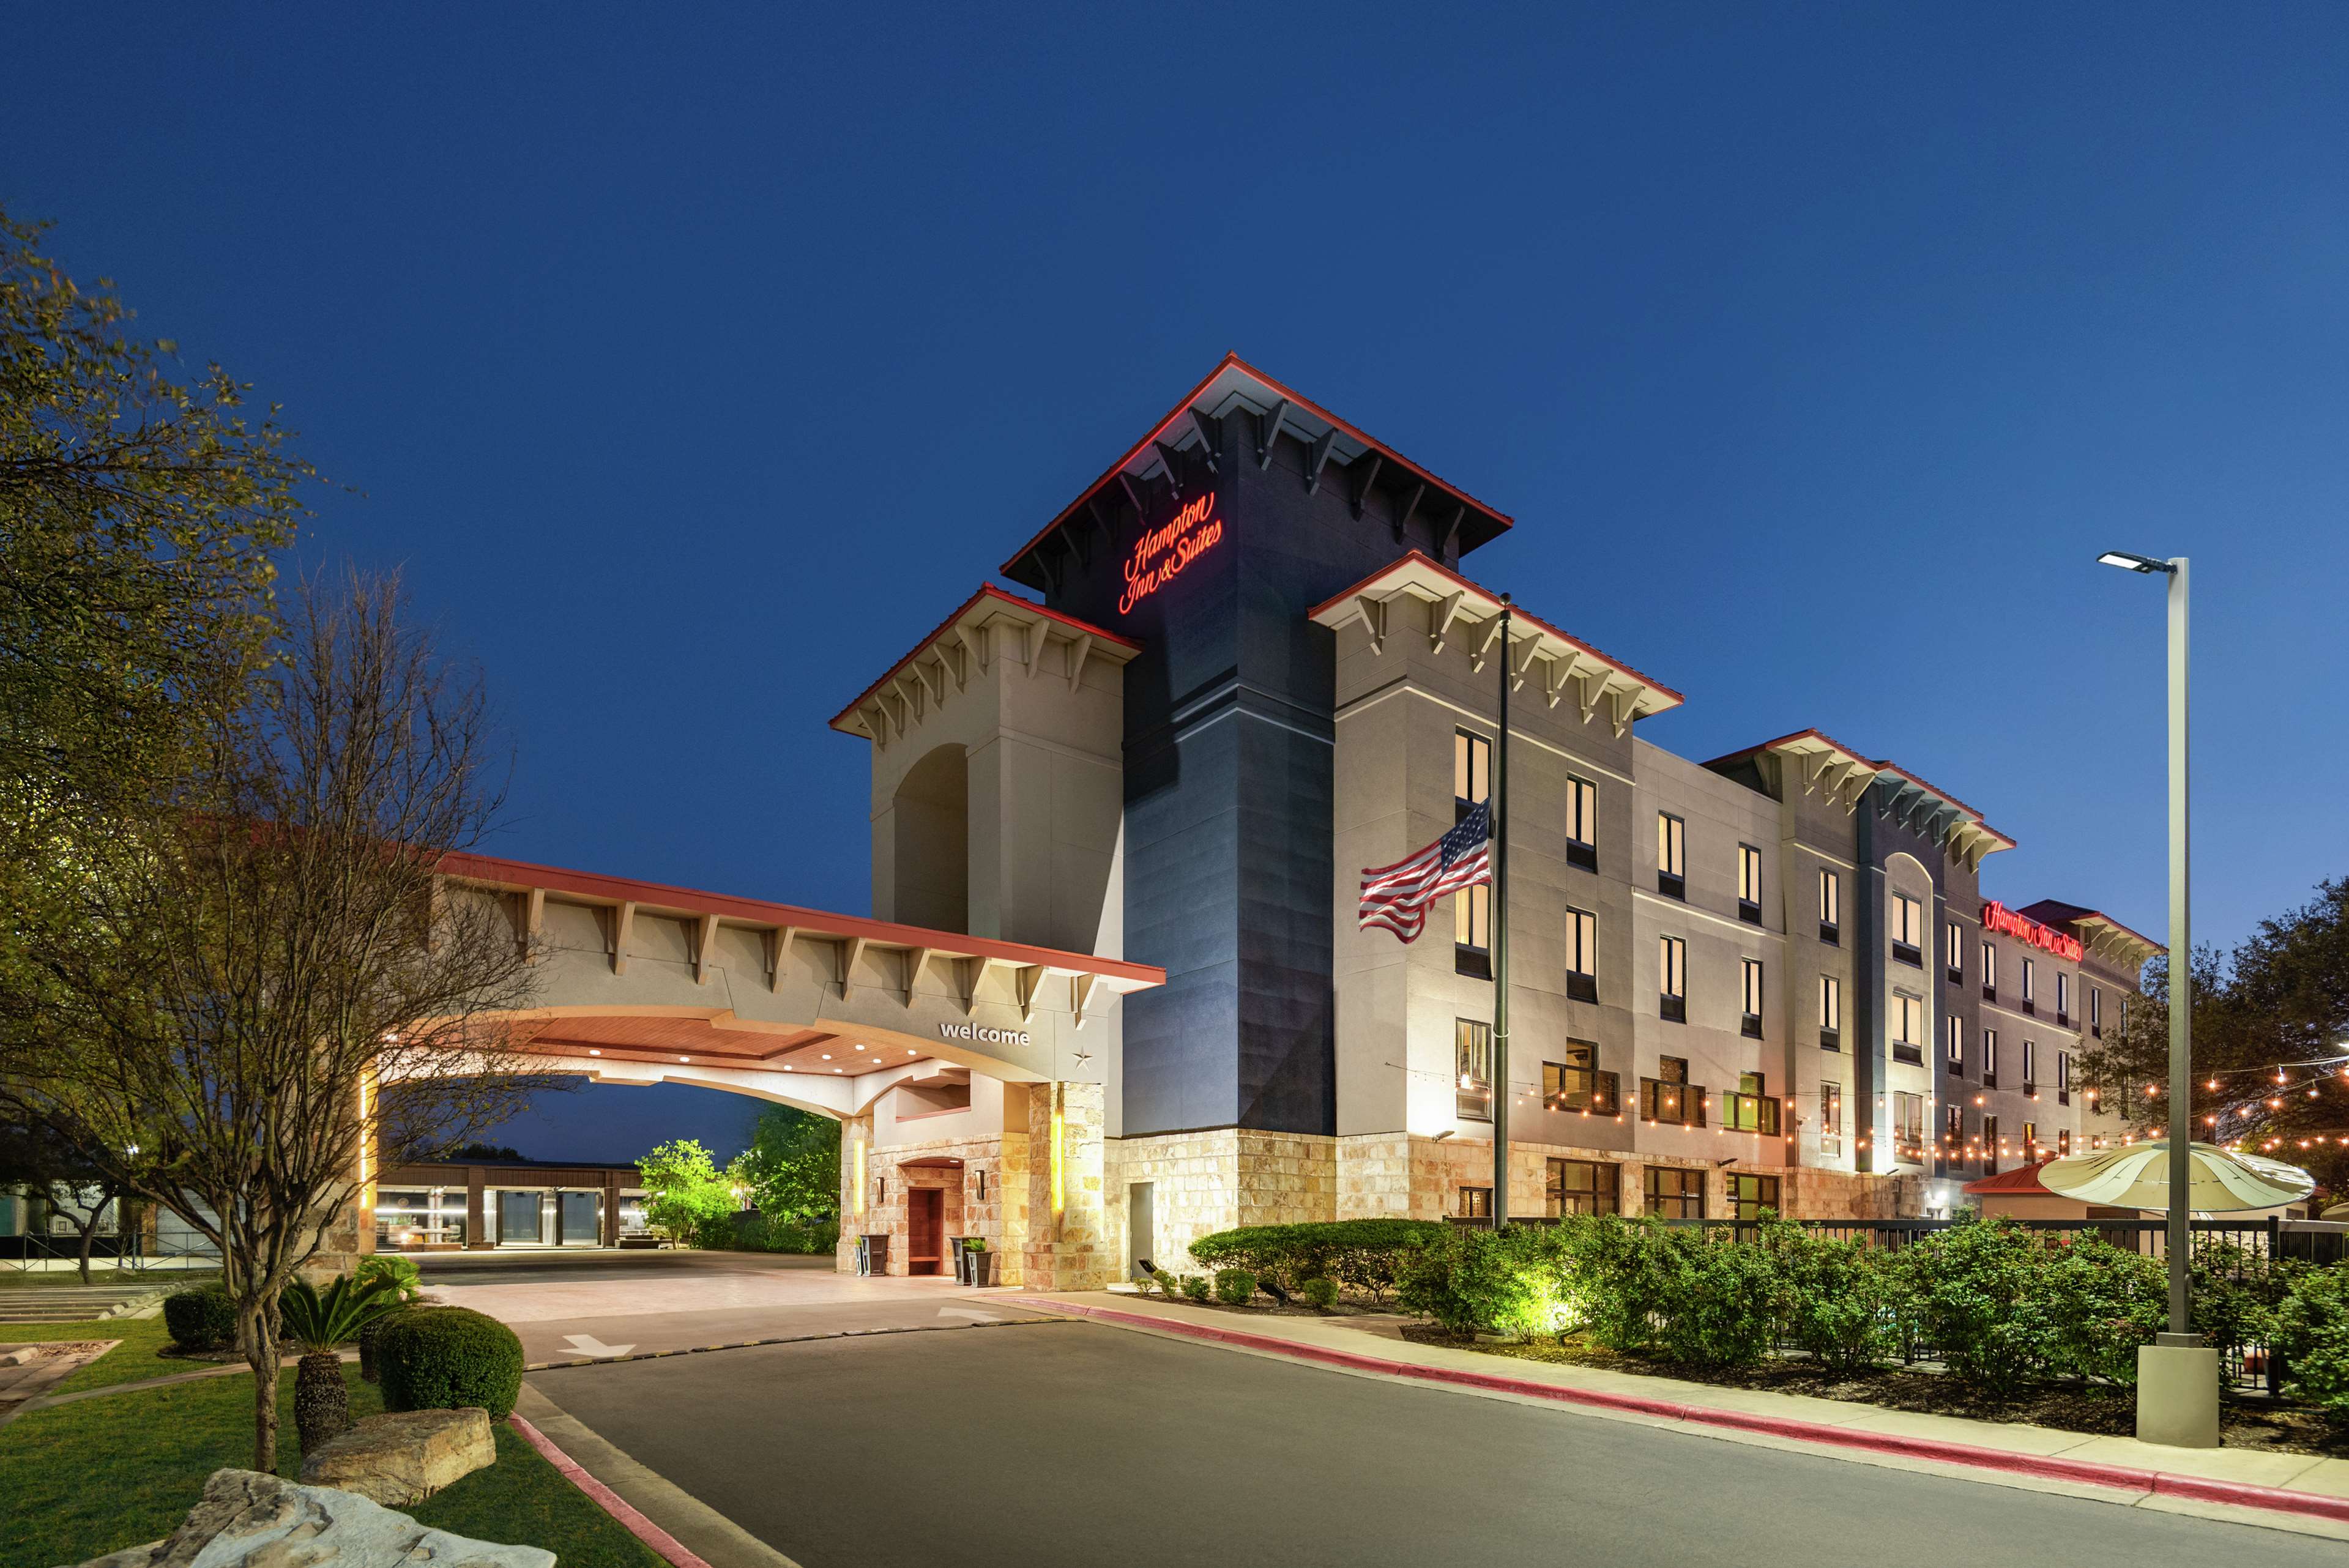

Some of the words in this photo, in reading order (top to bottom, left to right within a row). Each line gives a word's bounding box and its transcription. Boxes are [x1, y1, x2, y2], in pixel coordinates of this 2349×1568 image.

[1119, 567, 1161, 614] Inn
[1161, 558, 1173, 582] &
[1171, 519, 1222, 573] Suites
[1125, 491, 1215, 582] Hampton
[1985, 900, 2034, 943] Hampton
[2033, 924, 2056, 953] Inn
[2060, 934, 2083, 962] Suites
[939, 1022, 1030, 1046] welcome
